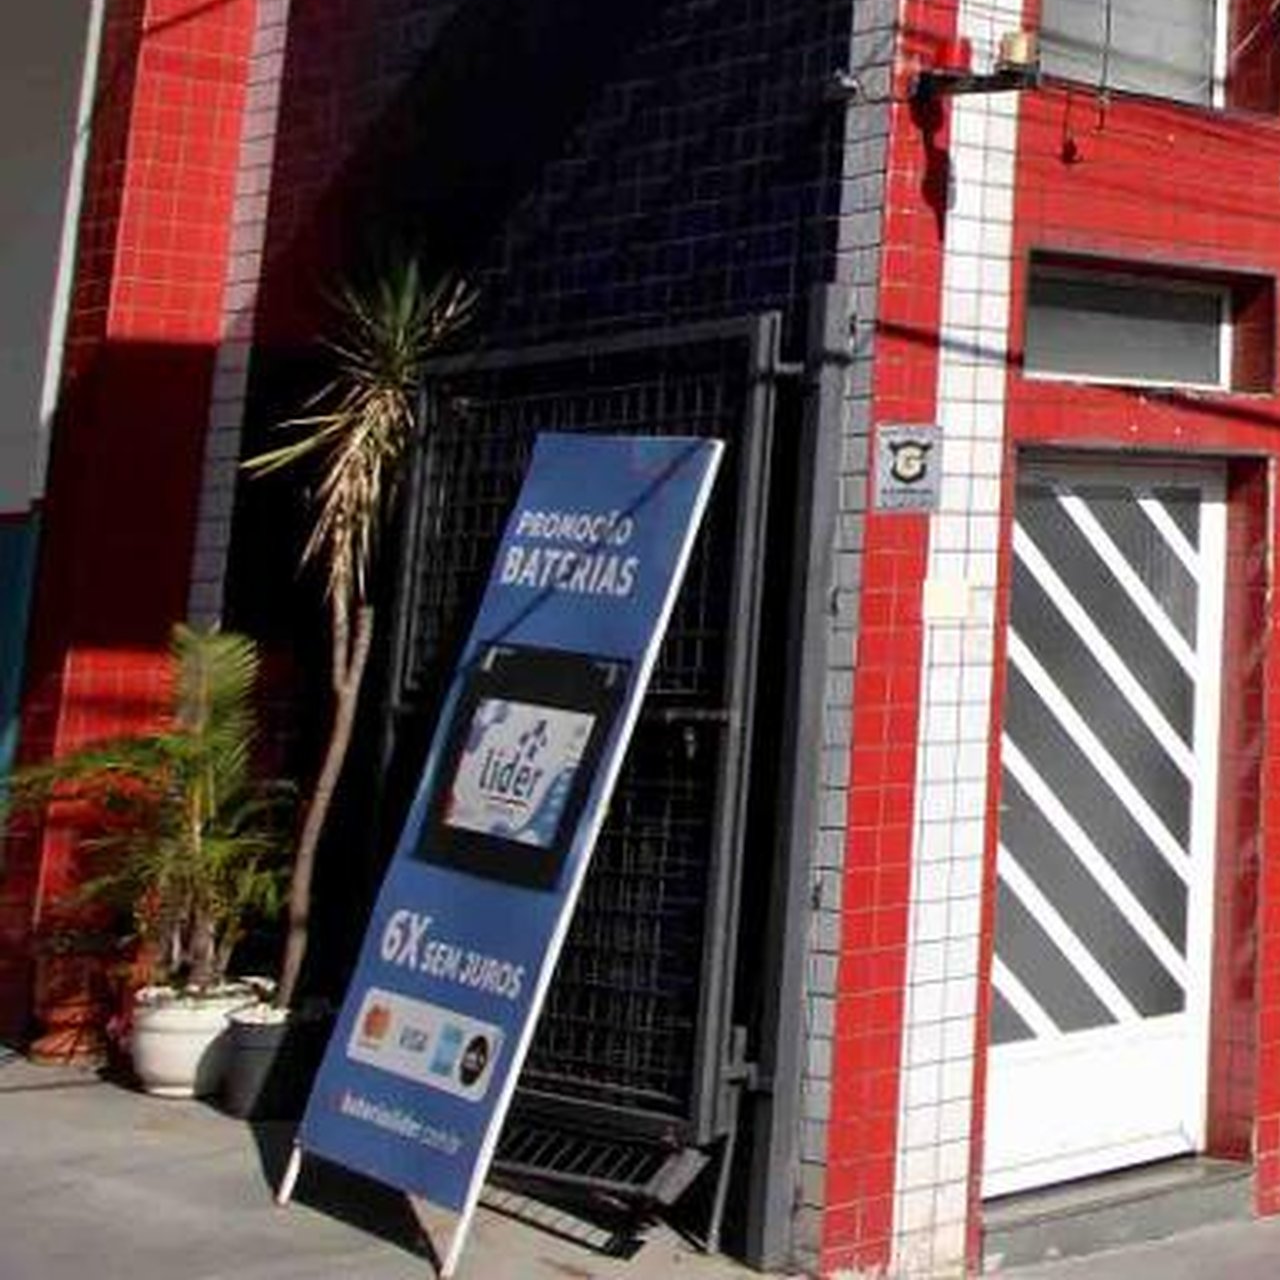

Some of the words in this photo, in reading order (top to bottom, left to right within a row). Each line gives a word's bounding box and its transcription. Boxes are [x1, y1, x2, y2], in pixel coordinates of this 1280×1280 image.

[500, 545, 641, 596] BATERIAS
[380, 909, 433, 970] 6X
[420, 941, 464, 983] SEM
[459, 948, 525, 1000] JUROS
